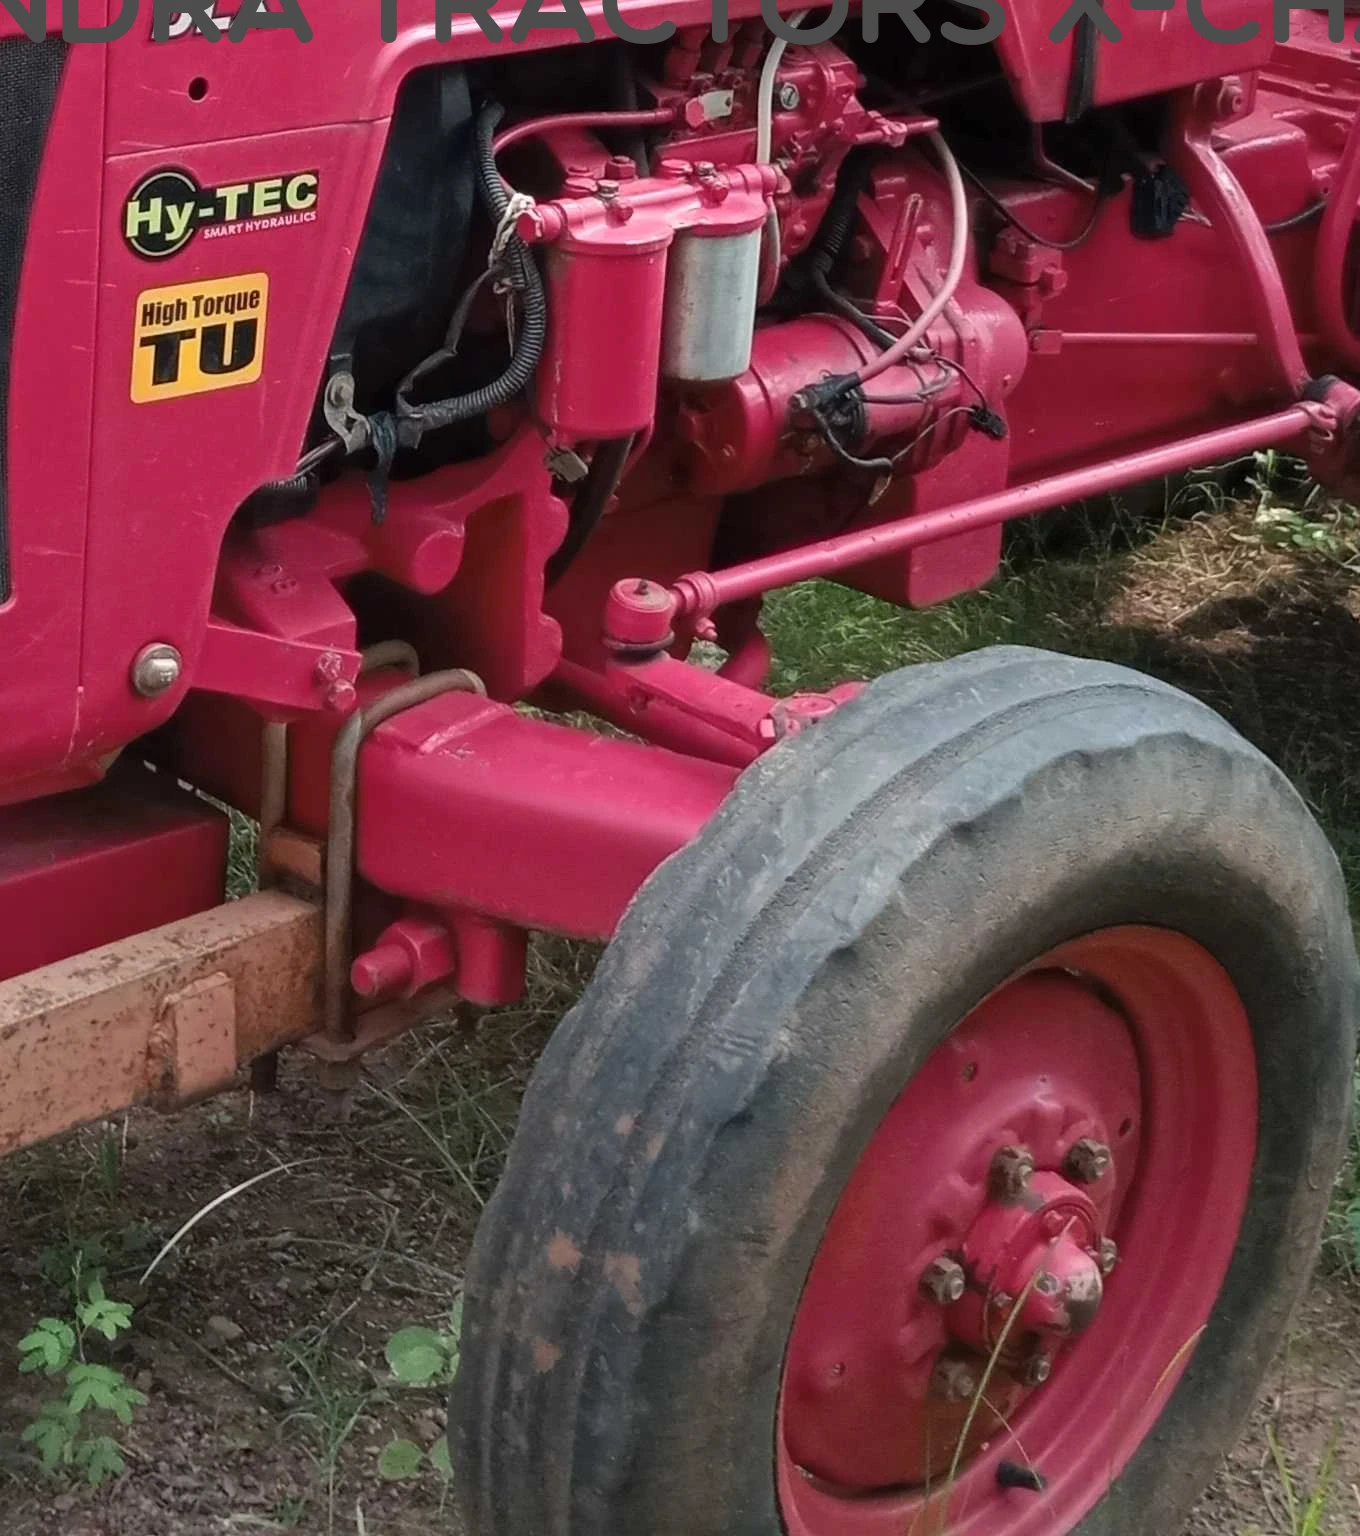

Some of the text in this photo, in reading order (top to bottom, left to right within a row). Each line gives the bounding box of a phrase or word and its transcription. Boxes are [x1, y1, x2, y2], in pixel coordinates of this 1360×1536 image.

[125, 173, 319, 242] Hy-TEC
[203, 210, 317, 240] SMART HYDRAULICS
[141, 288, 262, 328] High Torque
[140, 317, 257, 387] TU
